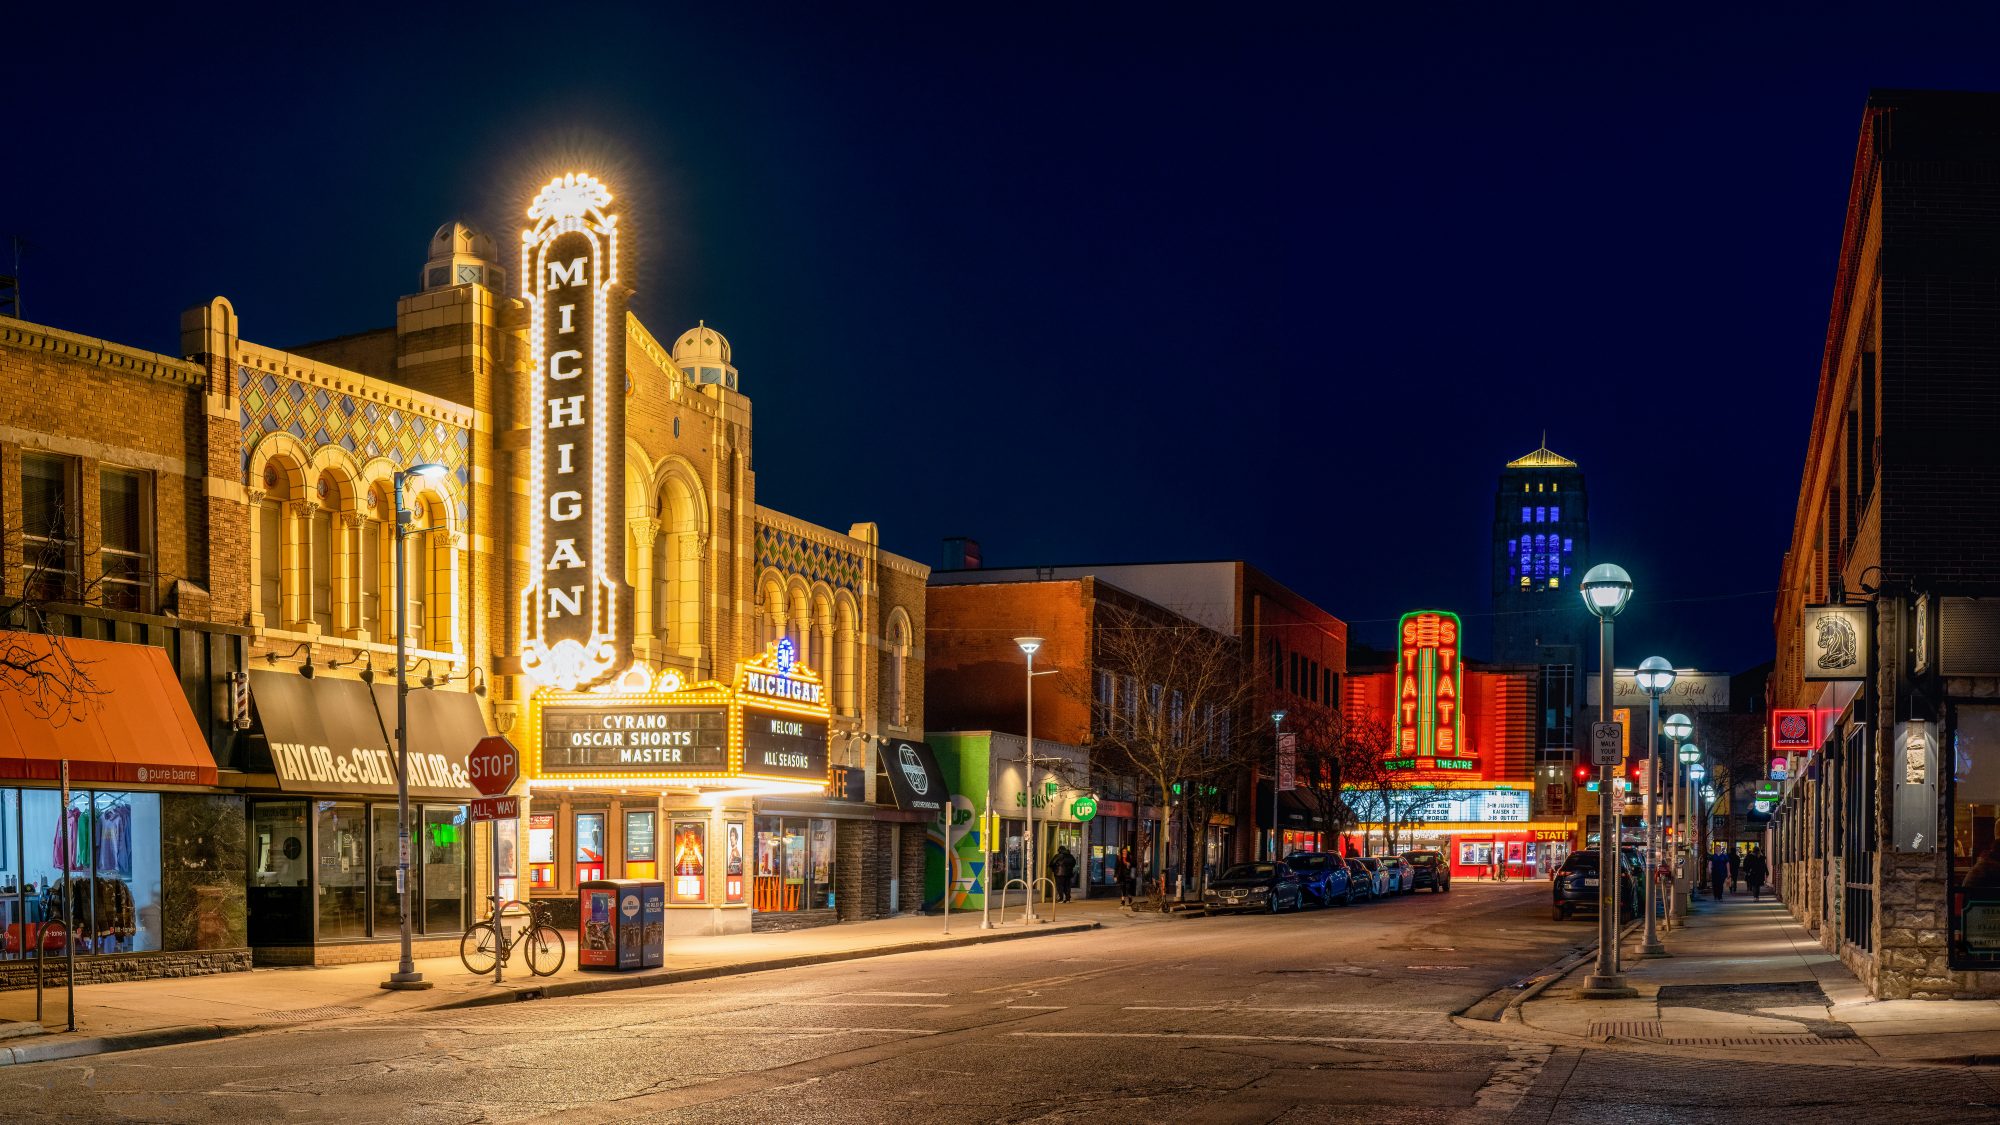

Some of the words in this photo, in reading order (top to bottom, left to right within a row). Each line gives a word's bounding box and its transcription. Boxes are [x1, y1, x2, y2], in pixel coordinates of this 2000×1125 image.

[547, 256, 588, 619] MICHIGAN
[781, 649, 789, 668] M
[748, 672, 820, 703] MICHIGAN
[1402, 623, 1417, 751] STATE
[1437, 623, 1455, 751] STATE
[1674, 680, 1706, 696] Hotel
[603, 715, 667, 729] CYRANO
[771, 720, 803, 736] WELCOME
[572, 732, 623, 746] OSCAR
[630, 731, 691, 746] SHORTS
[620, 749, 681, 763] MASTER
[764, 752, 776, 765] ALL
[779, 753, 808, 769] SEASONS
[1436, 759, 1473, 769] THEATRE
[149, 769, 171, 781] pure
[172, 768, 196, 780] barre
[471, 754, 513, 779] STOP
[472, 803, 489, 817] ALL
[496, 800, 515, 815] WAY
[1076, 807, 1093, 816] UP
[1537, 831, 1569, 840] STATE
